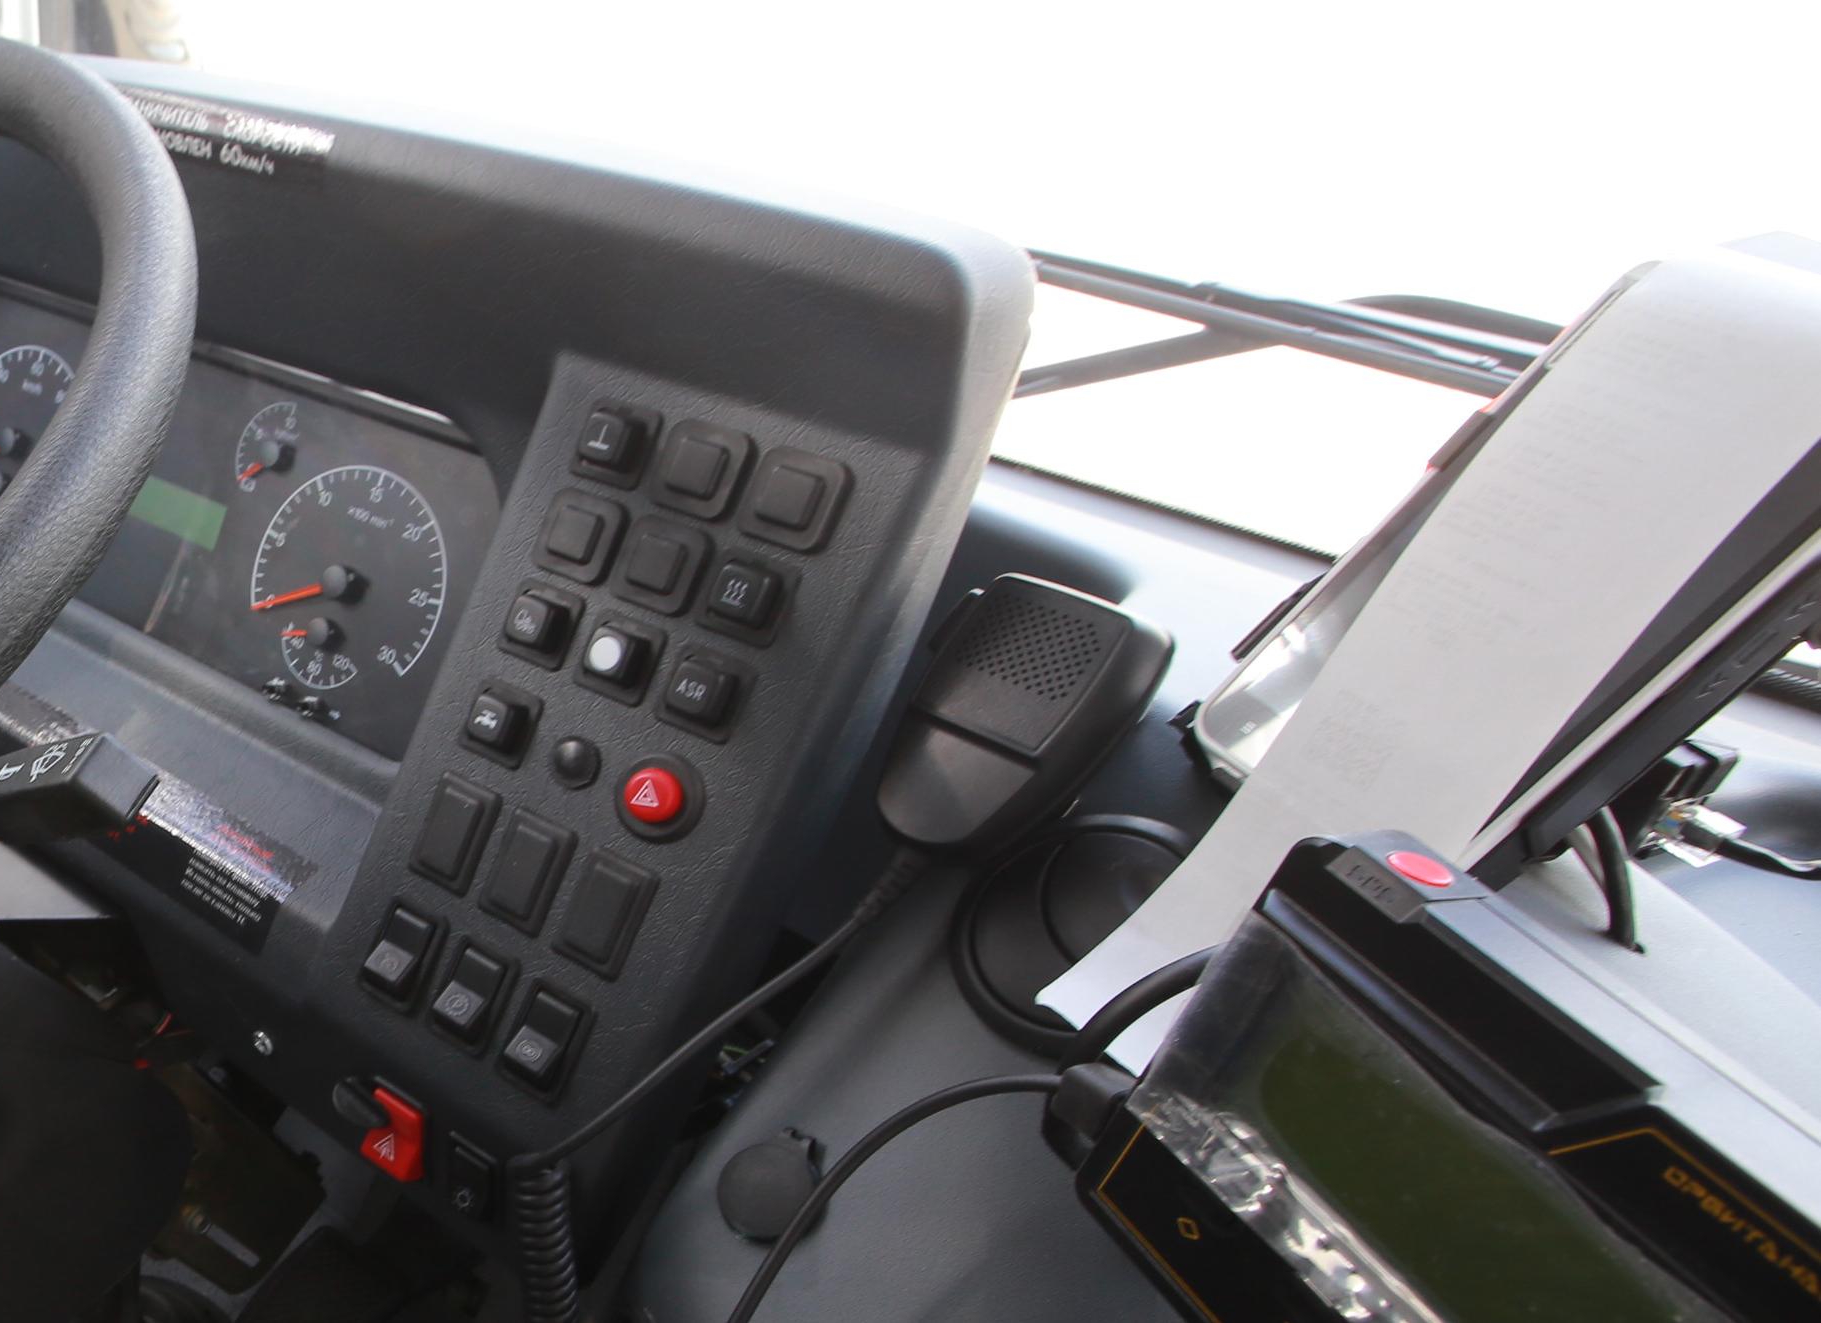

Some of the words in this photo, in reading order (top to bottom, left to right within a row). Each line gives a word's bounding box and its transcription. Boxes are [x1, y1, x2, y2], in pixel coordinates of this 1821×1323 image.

[318, 490, 332, 507] 10
[370, 486, 383, 503] 15
[401, 523, 421, 542] 20
[408, 588, 429, 607] 25
[377, 645, 397, 665] 30
[675, 678, 707, 701] ASR
